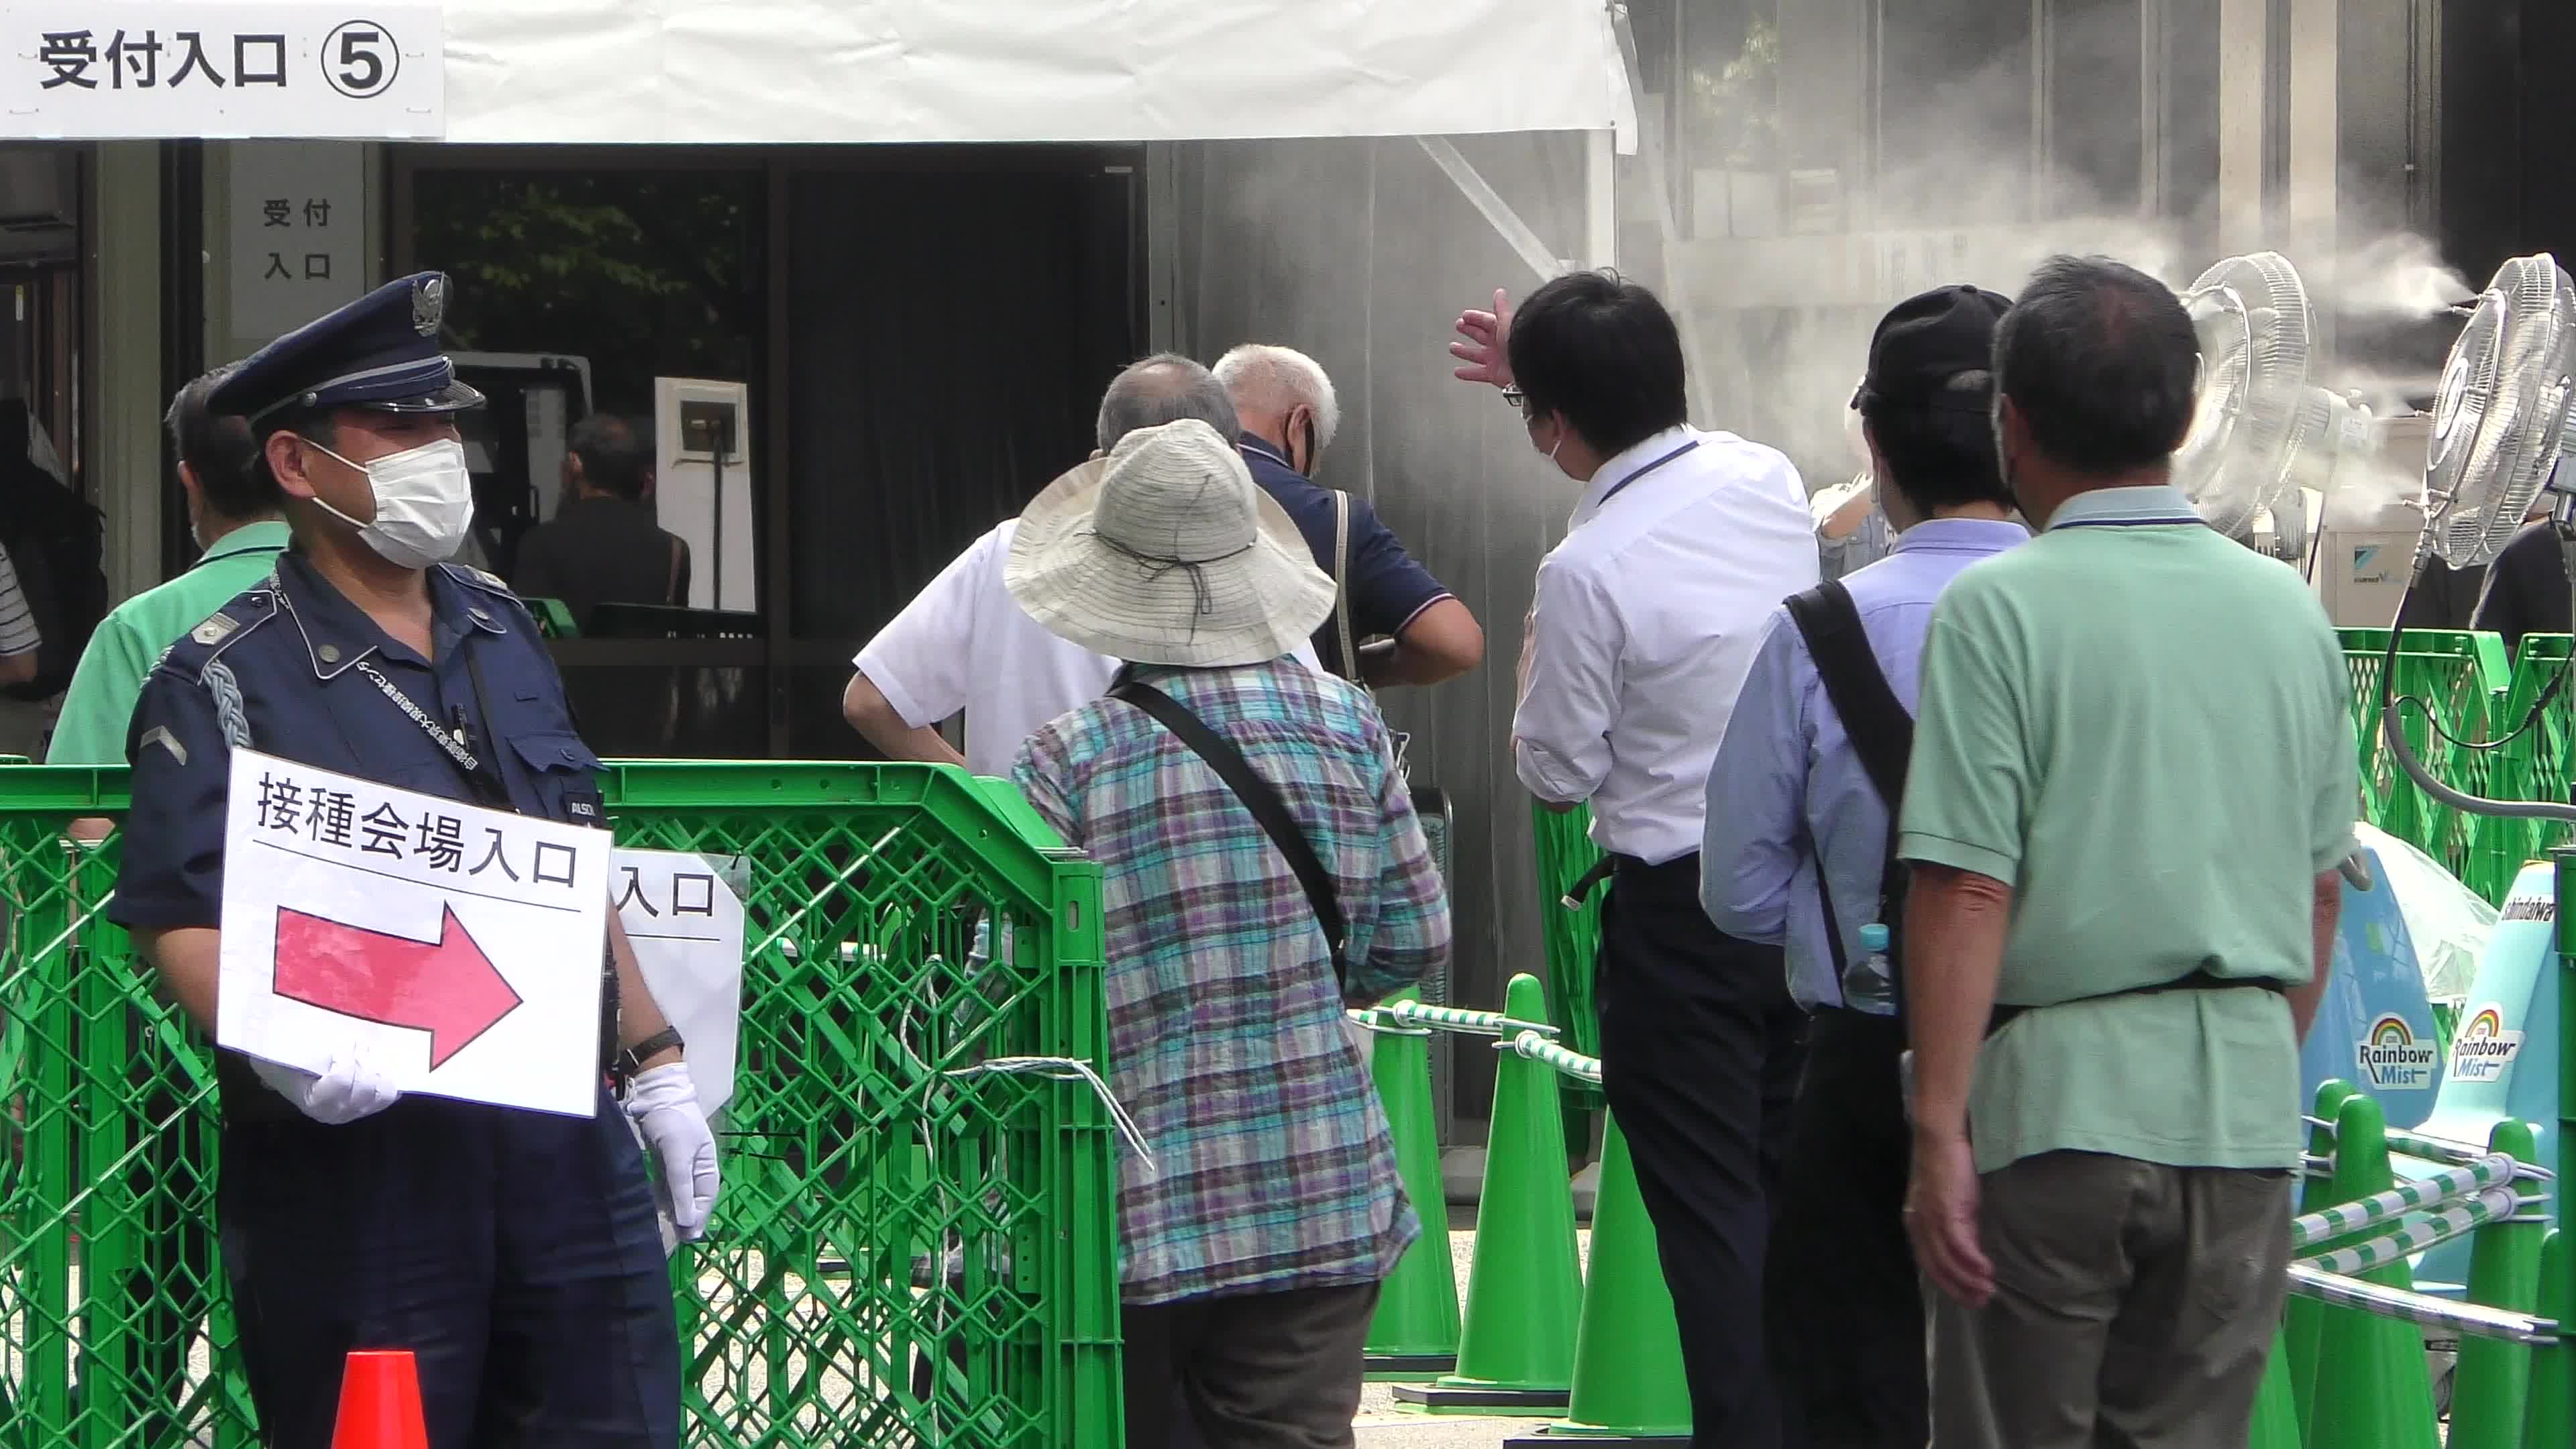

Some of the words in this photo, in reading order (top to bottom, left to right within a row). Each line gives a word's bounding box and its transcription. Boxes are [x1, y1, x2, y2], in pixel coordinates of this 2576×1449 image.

[39, 30, 288, 90] 受付入口
[263, 199, 332, 228] 受付
[264, 252, 331, 280] 入口
[258, 771, 578, 888] 接種会場入口
[616, 865, 714, 918] 入口
[2359, 1045, 2434, 1068] Rainbow
[2452, 1037, 2516, 1061] Rainbow
[2381, 1065, 2427, 1084] Mist
[2458, 1058, 2500, 1077] Mist
